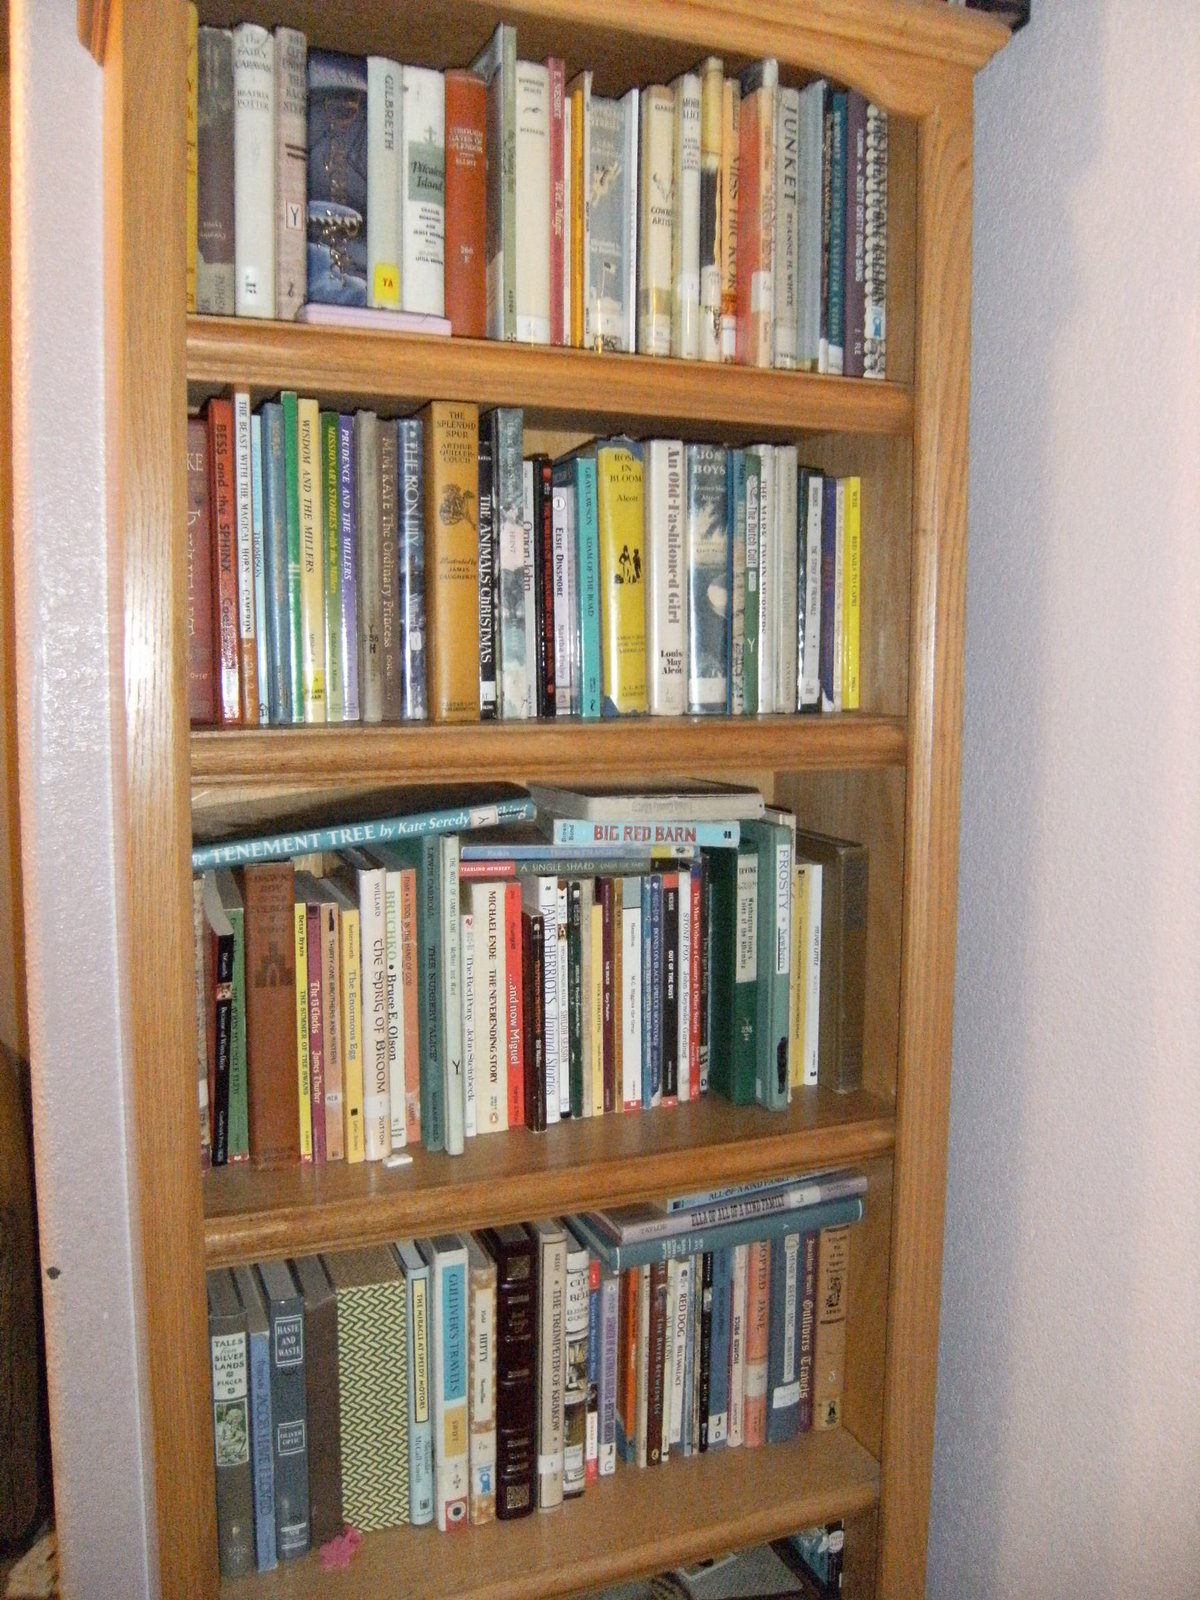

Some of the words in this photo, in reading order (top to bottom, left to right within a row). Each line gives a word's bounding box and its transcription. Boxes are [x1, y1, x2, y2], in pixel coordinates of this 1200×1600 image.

[383, 74, 395, 151] GILBRETH
[783, 105, 798, 205] JUNKET
[238, 401, 248, 417] THE
[450, 411, 463, 420] THE
[239, 421, 249, 449] BEAST
[437, 420, 476, 431] SPLENDID
[446, 430, 468, 439] SPUR
[215, 424, 228, 456] BESS
[301, 419, 312, 464] WISDOM
[239, 454, 249, 478] WITH
[327, 425, 337, 487] MISSIONARY
[341, 428, 351, 483] PRUDENCE
[403, 442, 419, 471] THE
[614, 453, 635, 463] ROSE
[666, 447, 681, 470] An
[217, 462, 229, 489] and
[302, 469, 313, 493] AND
[609, 474, 642, 483] BLOOM
[240, 482, 250, 500] THE
[342, 485, 351, 509] AND
[382, 474, 394, 510] KAYE
[404, 474, 419, 514] IRON
[218, 495, 230, 517] the
[303, 497, 313, 521] THE
[328, 488, 338, 529] STORIES
[747, 506, 757, 520] The
[240, 503, 251, 543] MAGICAL
[342, 511, 352, 533] THE
[382, 514, 394, 537] The
[666, 471, 682, 589] Old-Fashioned
[747, 522, 757, 546] Dutch
[219, 524, 232, 574] SPHINX
[304, 526, 315, 574] MILLERS
[522, 520, 534, 559] Onion
[555, 527, 565, 550] ELSIE
[241, 547, 251, 573] HORN
[343, 535, 353, 581] MILLERS
[380, 541, 395, 598] Ordinary
[330, 565, 338, 594] Millers
[522, 560, 534, 592] John
[556, 554, 566, 598] DINSMORE
[587, 575, 596, 591] THE
[242, 589, 252, 633] CAMERON
[587, 593, 597, 618] ROAD
[667, 592, 681, 624] Girl
[383, 599, 395, 649] Princess
[210, 832, 322, 864] TENEMENT
[326, 824, 378, 846] TREE
[379, 823, 395, 838] by
[397, 813, 427, 835] Kate
[428, 811, 471, 830] Seredy
[593, 824, 620, 842] BIG
[623, 825, 652, 842] RED
[654, 826, 697, 843] BARN
[532, 863, 562, 873] SINGLE
[566, 861, 595, 872] SHARD
[779, 849, 790, 911] FROSTY
[374, 882, 382, 917] WILLARD
[487, 890, 497, 933] MICHAEL
[298, 914, 306, 935] Betsy
[385, 890, 398, 961] BRUCHKO
[542, 903, 557, 941] JAMES
[682, 912, 690, 942] STONE
[298, 936, 306, 958] Byars
[488, 934, 498, 961] ENDE
[682, 944, 690, 963] FOX
[348, 970, 357, 990] The
[489, 969, 498, 988] THE
[544, 944, 559, 1005] HERRIOT'S
[668, 963, 674, 971] OF
[310, 981, 320, 998] The
[311, 998, 320, 1007] 13
[387, 974, 398, 1010] Bruce
[300, 1007, 308, 1040] SUMMER
[311, 1008, 321, 1034] Clocks
[349, 992, 358, 1041] Enormous
[387, 1010, 398, 1025] E.
[489, 989, 498, 1053] NEVERENDING
[509, 1005, 518, 1027] now
[301, 1041, 308, 1051] OF
[348, 1042, 358, 1061] Egg
[388, 1025, 400, 1061] Olson
[508, 1028, 521, 1066] Miguel
[311, 1050, 322, 1074] James
[375, 1040, 387, 1094] BROOM
[489, 1054, 498, 1084] STORY
[313, 1075, 322, 1104] Thurber
[466, 1053, 476, 1102] Steinbeck
[545, 1057, 560, 1097] Stories
[416, 1294, 424, 1309] THE
[448, 1273, 460, 1340] GULLIVER'S
[552, 1288, 562, 1309] THE
[677, 1293, 688, 1312] RED
[277, 1323, 300, 1335] HASTE
[416, 1309, 424, 1340] MIRACLE
[676, 1314, 687, 1338] DOG
[213, 1337, 244, 1348] TALES
[278, 1345, 302, 1357] WASTE
[281, 1335, 297, 1346] AND
[417, 1342, 424, 1352] AT
[479, 1332, 488, 1363] HITTY
[552, 1311, 562, 1373] TRUMPETER
[214, 1361, 245, 1371] LANDS
[417, 1353, 425, 1378] SPEEDY
[449, 1344, 461, 1393] TRAVELS
[551, 1374, 561, 1387] OF
[418, 1380, 426, 1410] MOTORS
[551, 1389, 561, 1431] KRAKOW
